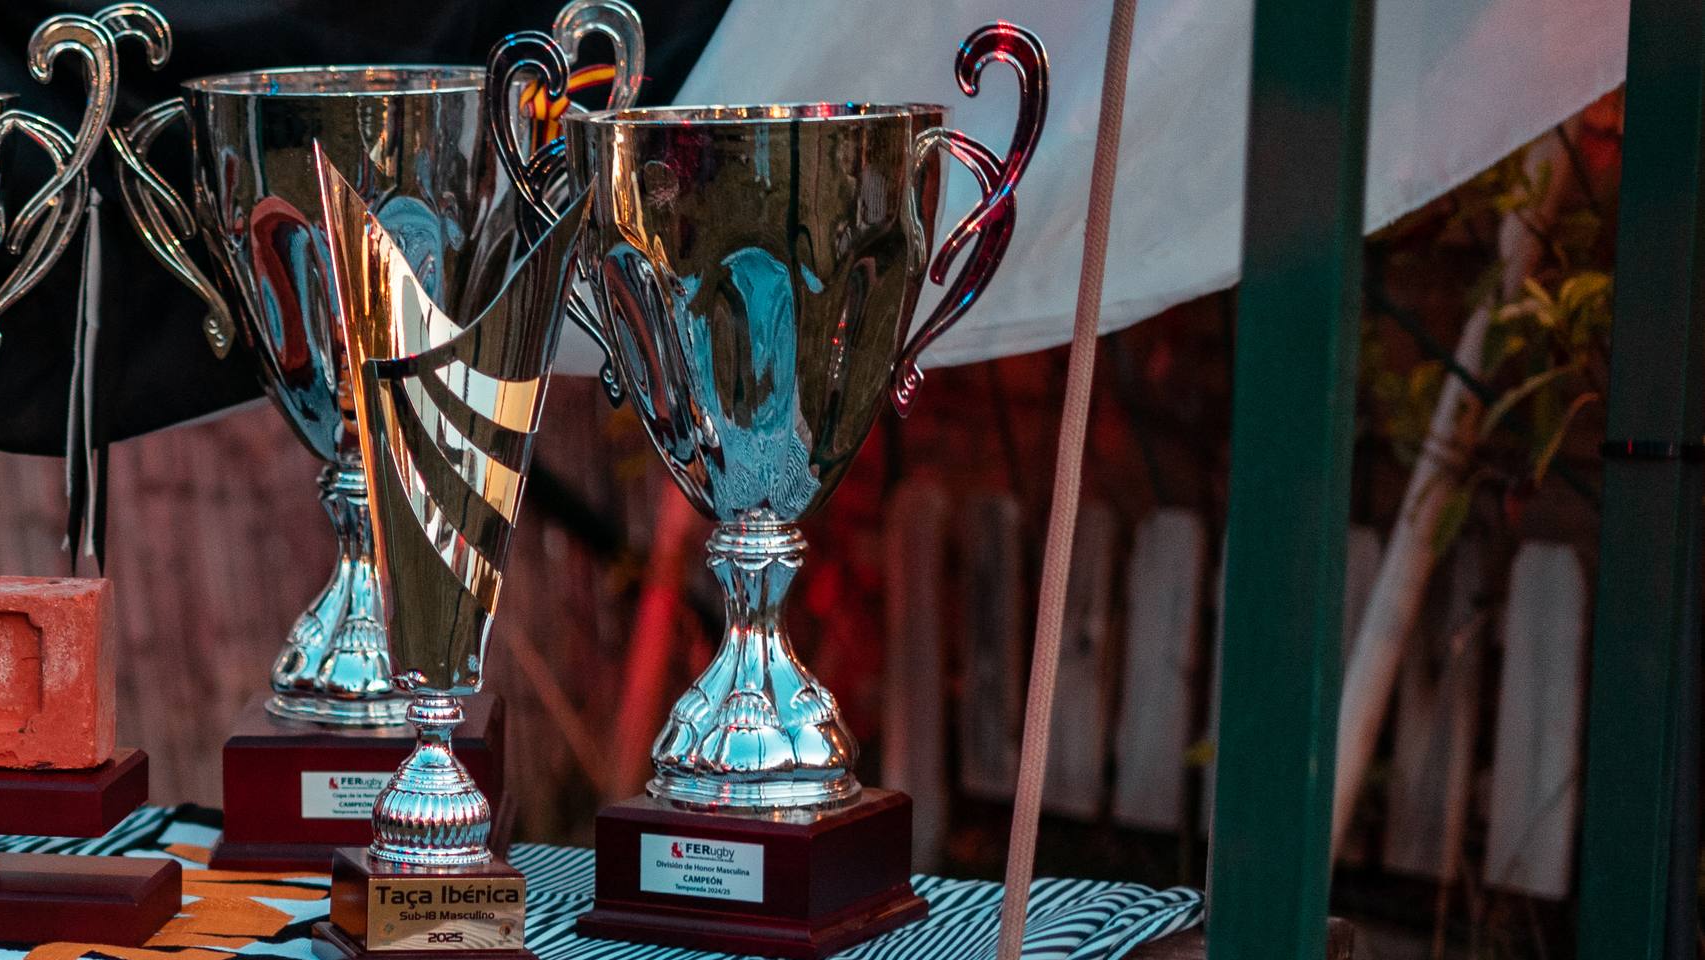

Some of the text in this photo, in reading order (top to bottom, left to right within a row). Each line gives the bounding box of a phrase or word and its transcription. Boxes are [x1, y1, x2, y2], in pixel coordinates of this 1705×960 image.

[685, 842, 735, 859] FERugby
[656, 860, 750, 876] División de Honor Masculina
[675, 884, 707, 893] Temporada
[375, 884, 519, 909] Taça Ibérica
[400, 911, 495, 921] Sub-18 Masculino
[427, 932, 464, 943] 2025
